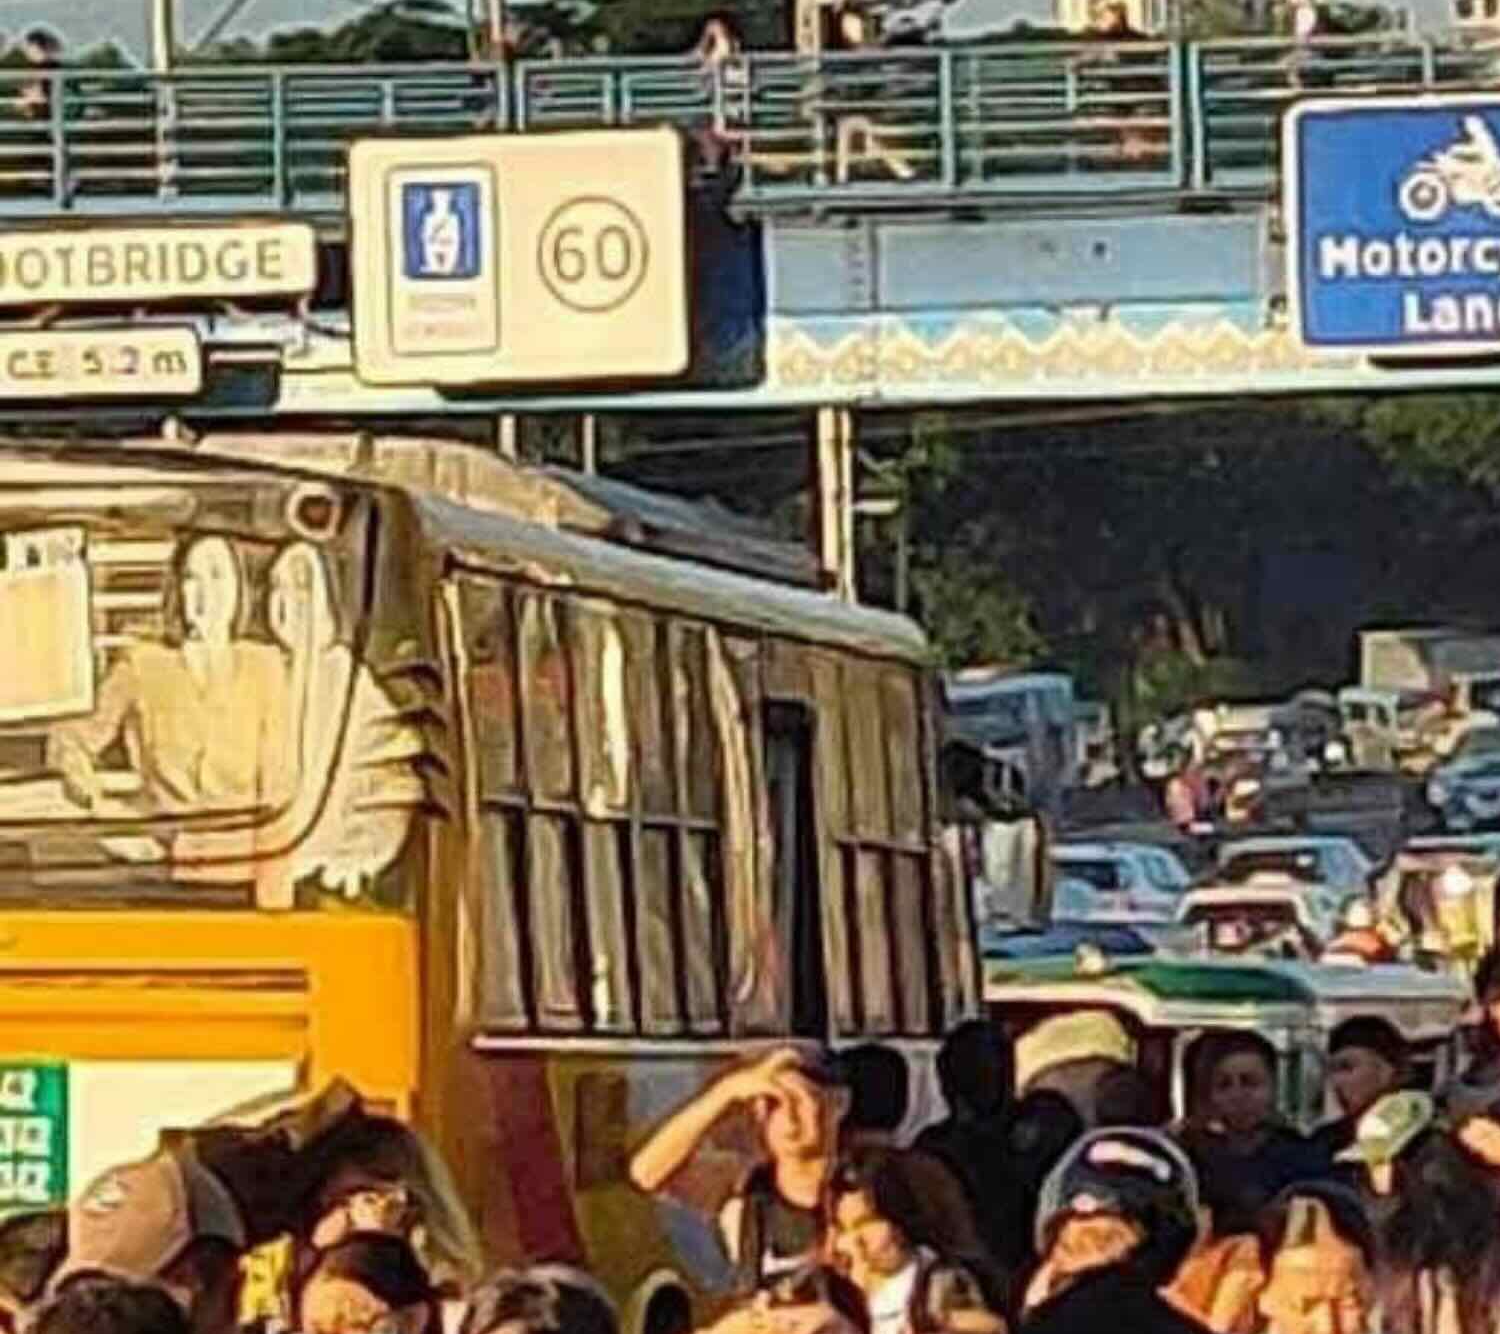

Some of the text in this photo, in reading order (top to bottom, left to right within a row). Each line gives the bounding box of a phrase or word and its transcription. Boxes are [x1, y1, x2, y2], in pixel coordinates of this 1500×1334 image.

[0, 240, 283, 289] OTBRIDGE
[553, 224, 632, 284] 60
[153, 348, 187, 374] m
